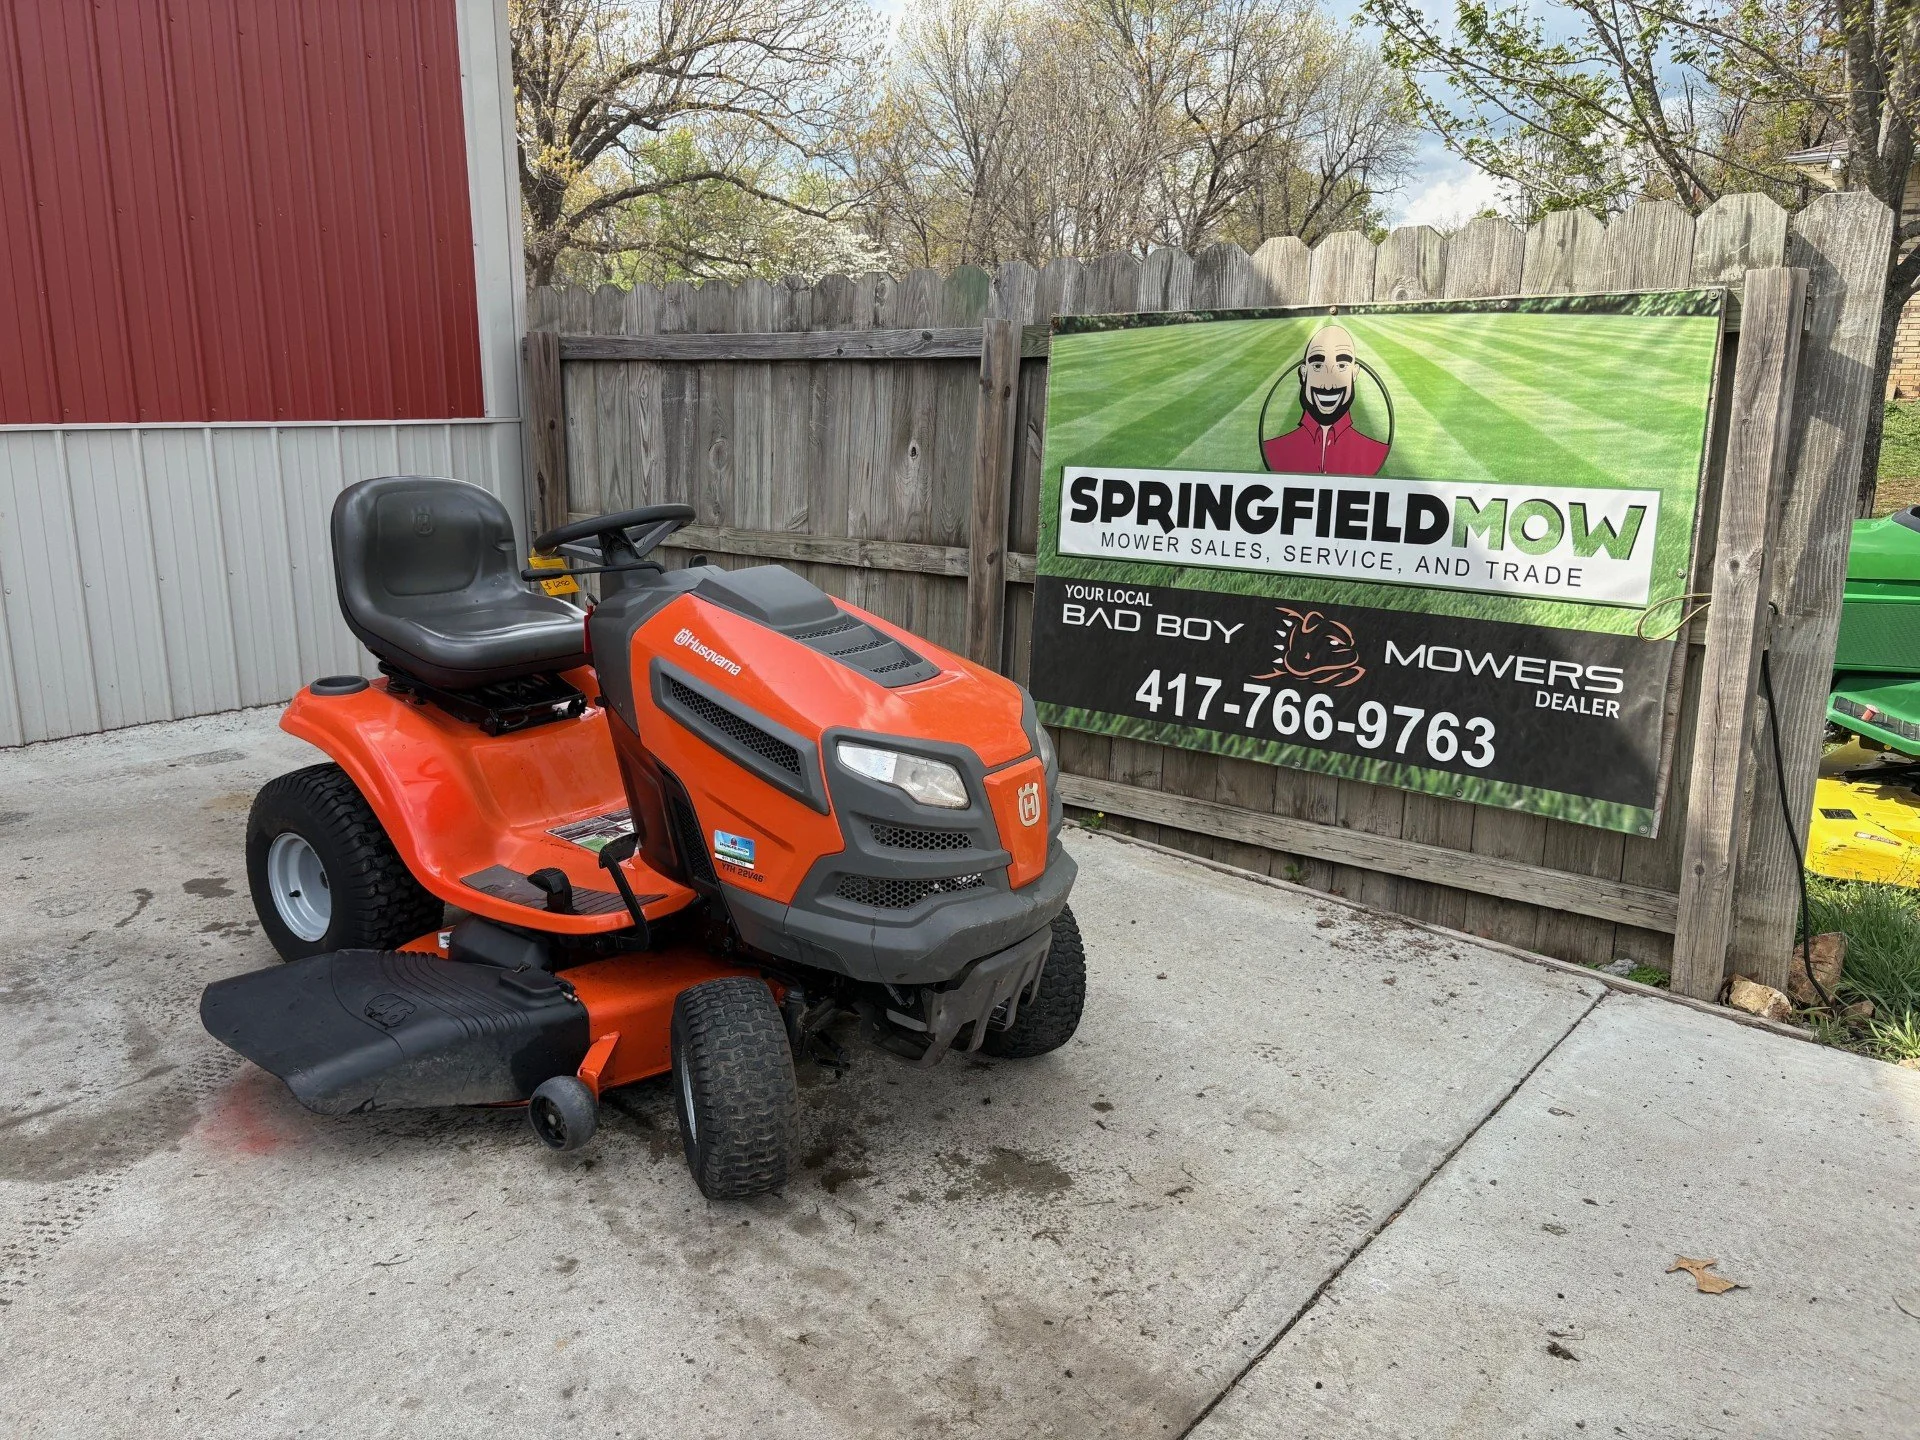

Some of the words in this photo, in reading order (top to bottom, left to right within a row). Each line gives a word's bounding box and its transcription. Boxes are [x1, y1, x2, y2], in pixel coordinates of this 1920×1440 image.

[1069, 477, 1647, 561] SPRINGFIELDMOW
[1100, 531, 1181, 555] MOWER
[1191, 536, 1272, 564] SALES,
[1283, 544, 1403, 575] SERVICE,
[1414, 554, 1471, 579] AND
[1486, 560, 1583, 588] TRADE
[1064, 584, 1106, 602] YOUR
[1107, 588, 1153, 607] LOCAL
[1062, 603, 1142, 632] BAD
[1155, 611, 1245, 645] BOY
[685, 634, 742, 676] Husqvarna
[1384, 639, 1624, 695] MOWERS
[1135, 668, 1497, 769] 417-766-9763
[1534, 690, 1620, 719] DEALER
[721, 862, 736, 874] YTH
[737, 868, 764, 883] 22V46
